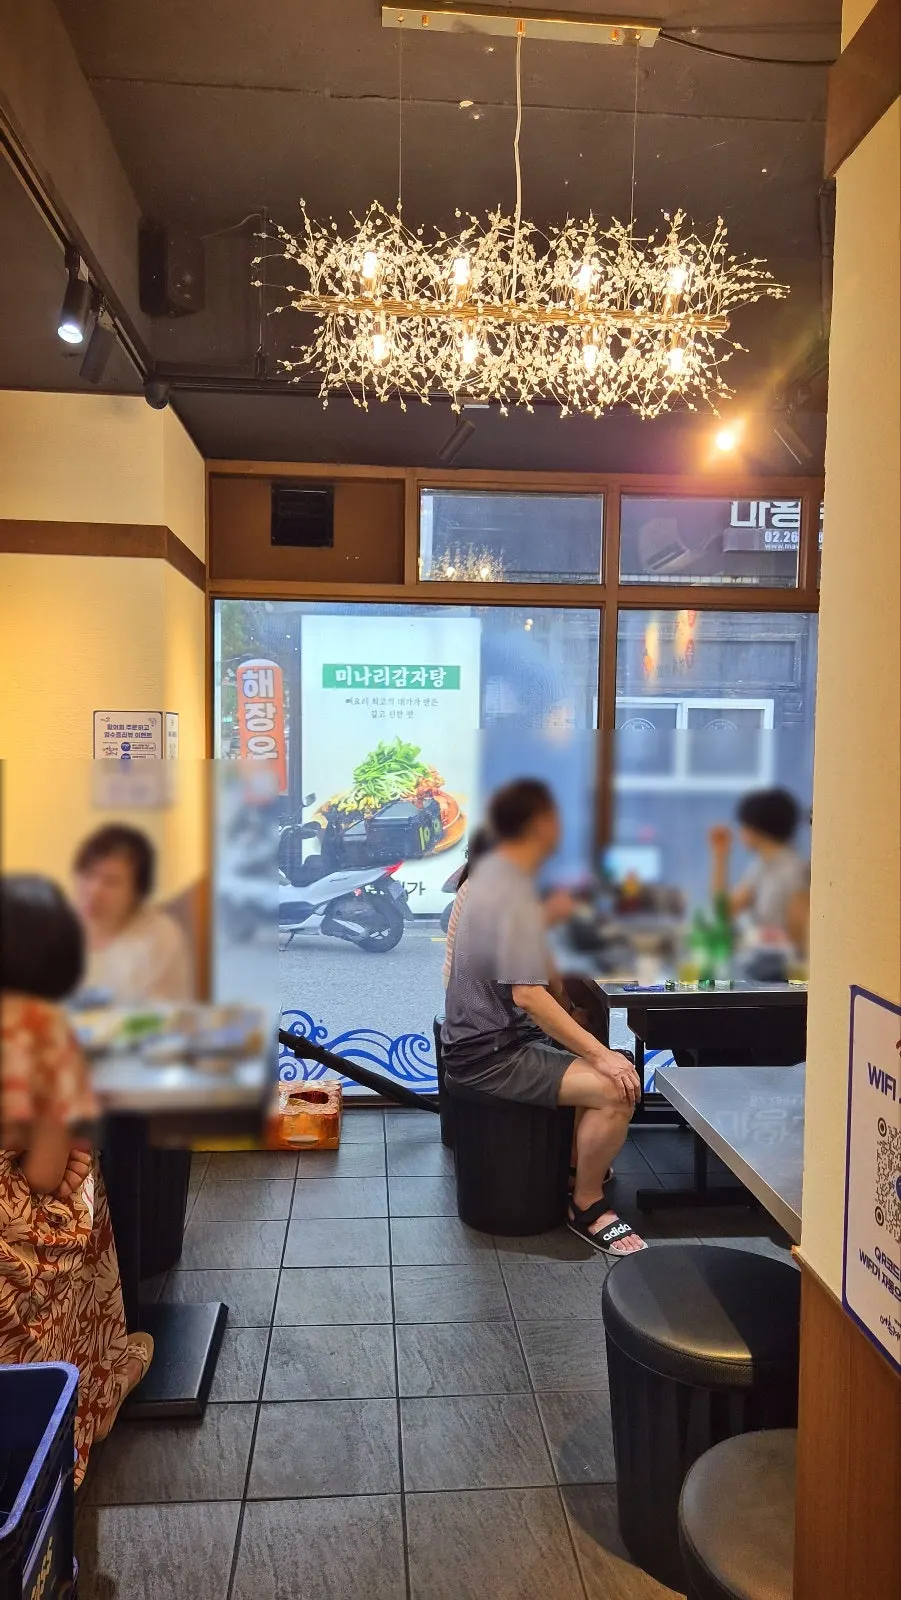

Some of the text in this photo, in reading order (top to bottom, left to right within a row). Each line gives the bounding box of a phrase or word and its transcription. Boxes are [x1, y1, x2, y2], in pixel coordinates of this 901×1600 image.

[335, 667, 447, 688] 미나리감자탕
[867, 1062, 897, 1101] WIFI
[603, 1223, 632, 1241] adida
[874, 1246, 901, 1283] QR코드
